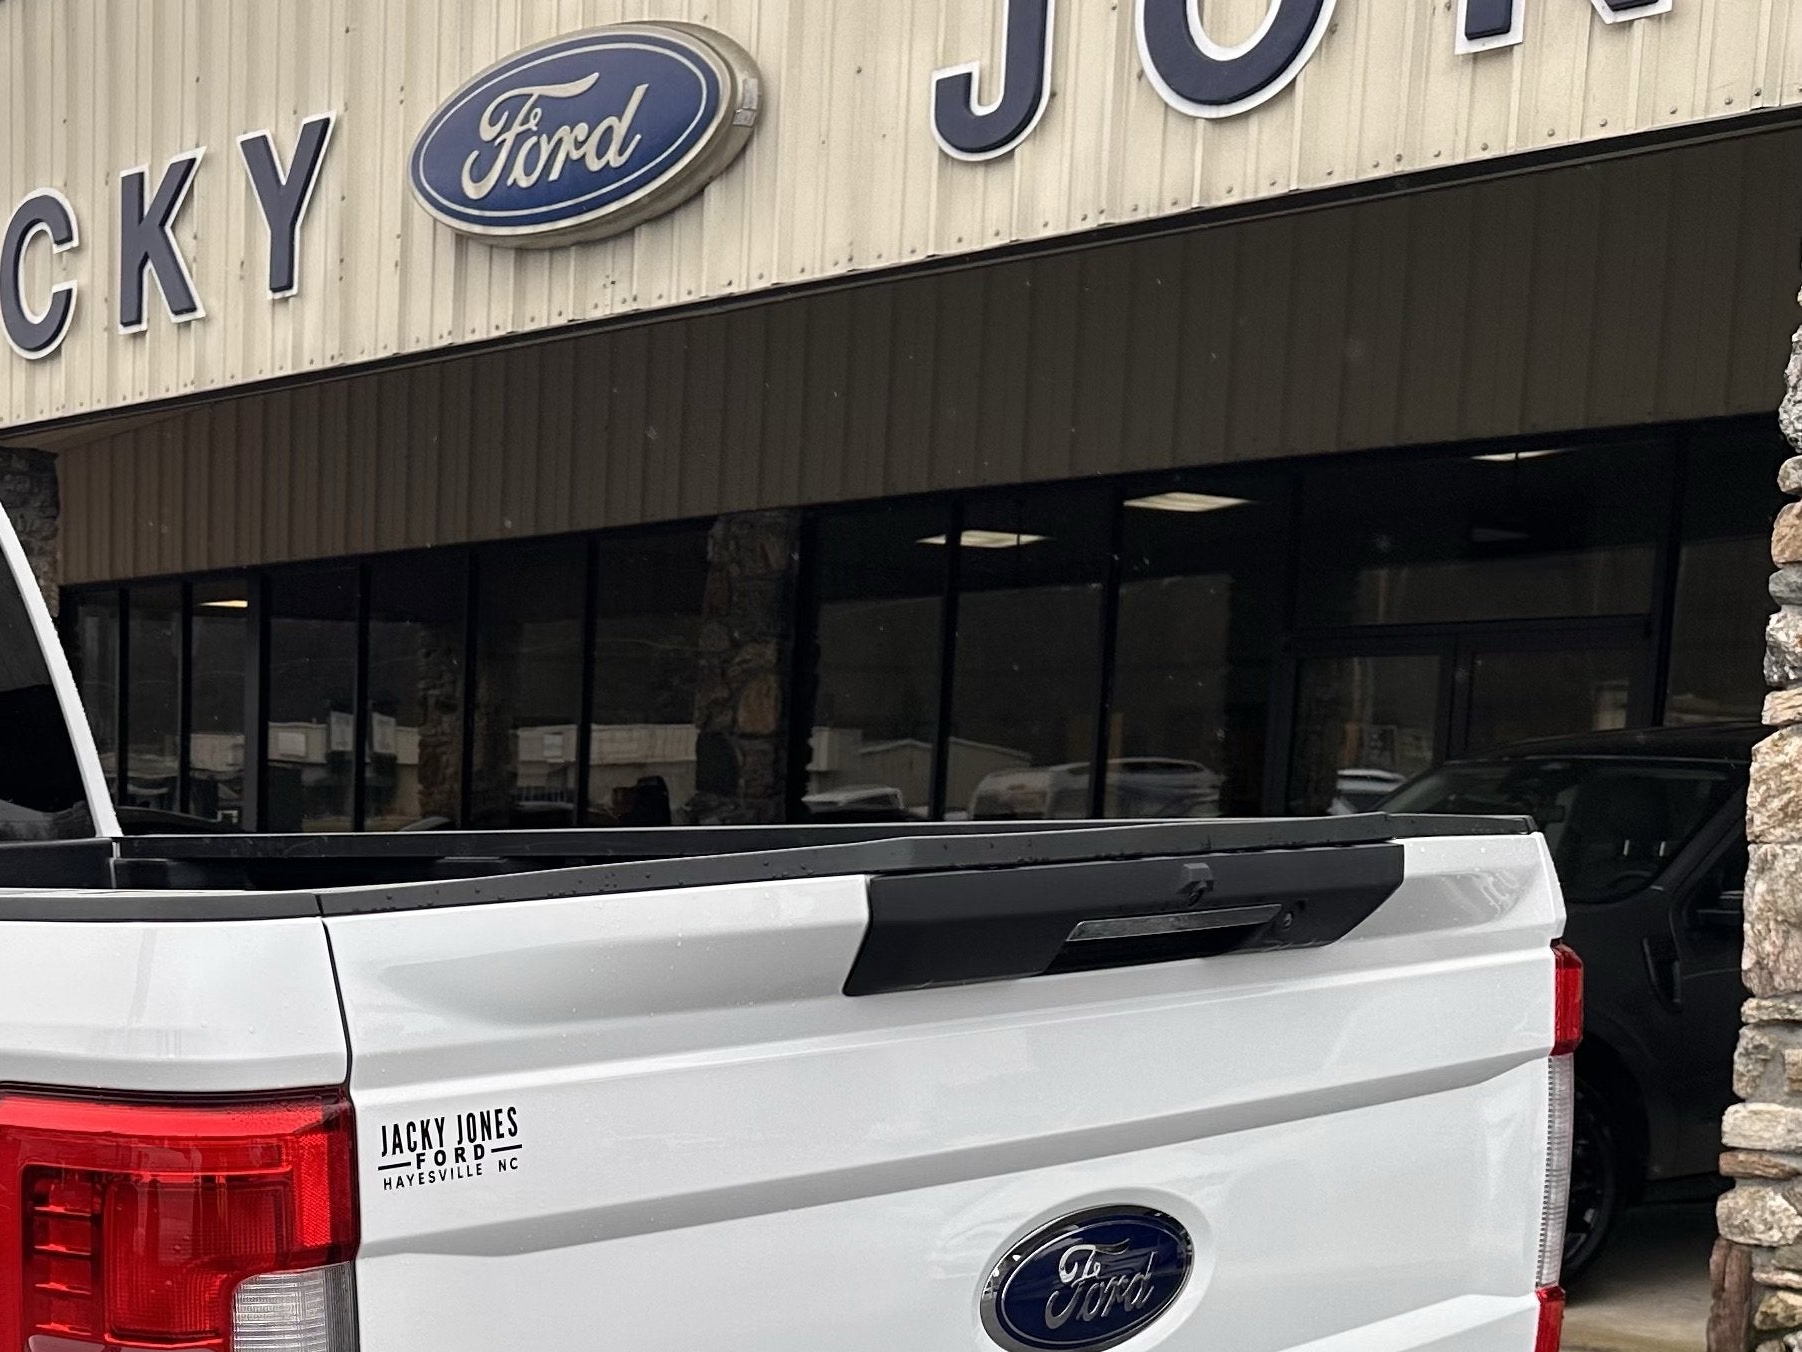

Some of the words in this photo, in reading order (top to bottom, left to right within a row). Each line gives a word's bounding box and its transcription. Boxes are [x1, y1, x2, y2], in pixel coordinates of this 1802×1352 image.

[463, 71, 647, 202] Ford
[380, 1116, 446, 1158] JACKY
[456, 1105, 519, 1146] JONES
[415, 1143, 486, 1170] FORD
[383, 1162, 483, 1191] HAYESVILLE
[498, 1156, 519, 1173] NC
[1044, 1237, 1159, 1330] Ford
